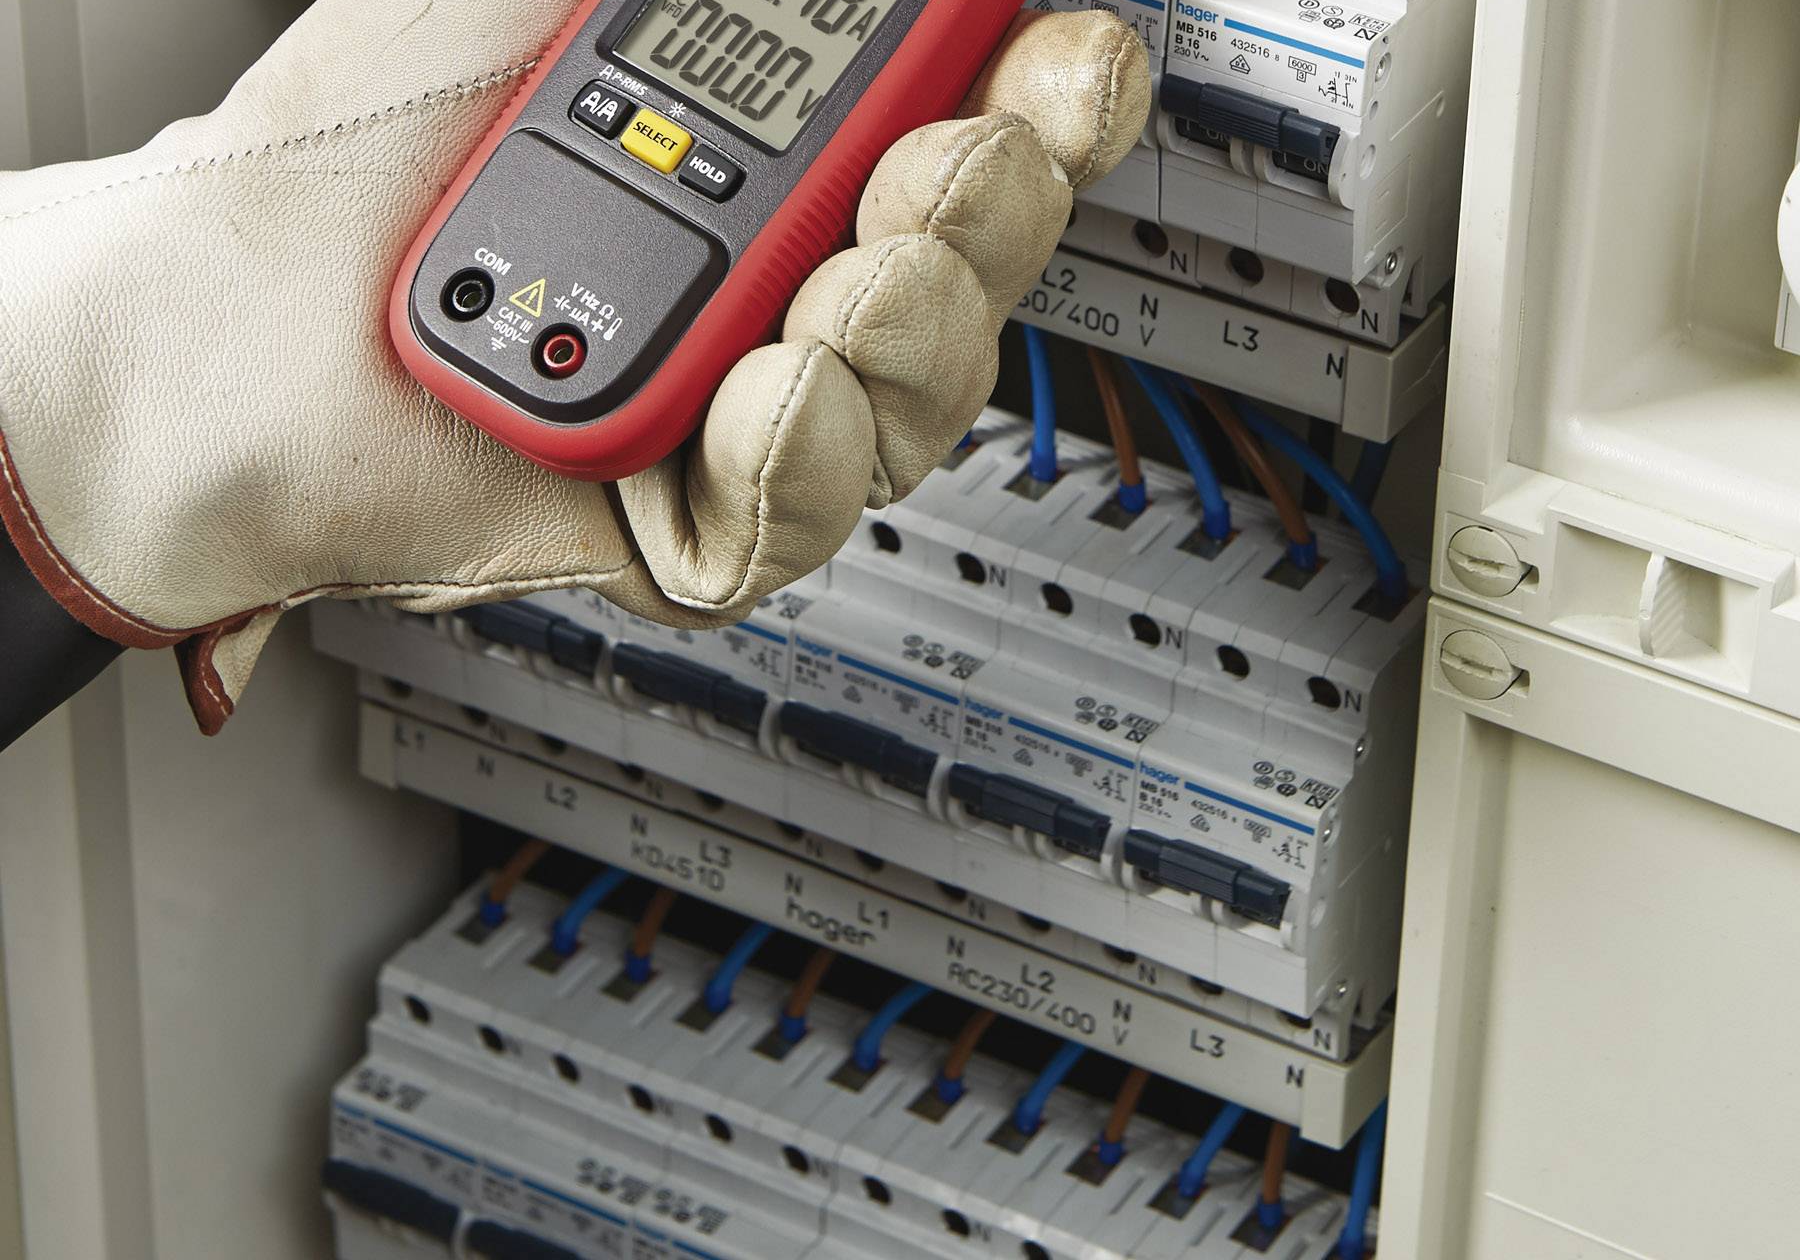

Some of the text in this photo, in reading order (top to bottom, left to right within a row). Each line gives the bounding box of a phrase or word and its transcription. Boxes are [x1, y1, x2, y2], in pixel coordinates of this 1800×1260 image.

[661, 0, 683, 18] VFD
[846, 6, 877, 41] A
[1176, 20, 1217, 41] MB 516
[1174, 46, 1191, 57] 230
[1175, 34, 1200, 50] B 16
[1231, 38, 1270, 58] 432516
[1291, 60, 1313, 72] 6000
[796, 89, 824, 120] V
[633, 121, 678, 152] SELECT
[689, 156, 726, 184] HOLD
[1304, 157, 1329, 175] ON
[474, 247, 512, 276] COM
[1170, 250, 1187, 273] N
[571, 282, 615, 320] V Hz Ω
[493, 320, 522, 341] 600V
[498, 306, 534, 333] CAT III
[1362, 309, 1378, 333] N
[1140, 324, 1155, 346] V
[1141, 294, 1158, 319] N
[1224, 321, 1259, 351] L3
[1327, 354, 1344, 378] N
[990, 565, 1006, 587] N
[1166, 626, 1182, 649] N
[1345, 690, 1362, 712] N
[1139, 761, 1179, 785] hager
[969, 900, 986, 920] N
[545, 781, 578, 811] L2
[631, 813, 647, 837] N
[700, 840, 732, 869] L3
[785, 872, 802, 896] N
[858, 902, 889, 929] L1
[948, 936, 965, 958] N
[1020, 963, 1055, 994] L2
[1113, 999, 1131, 1023] N
[1189, 1030, 1226, 1058] L3
[1286, 1065, 1304, 1089] N
[786, 897, 878, 945] hager
[948, 962, 1096, 1035] AC230/400
[1113, 1026, 1128, 1046] V
[1139, 964, 1156, 985] N
[1314, 1028, 1331, 1050] N
